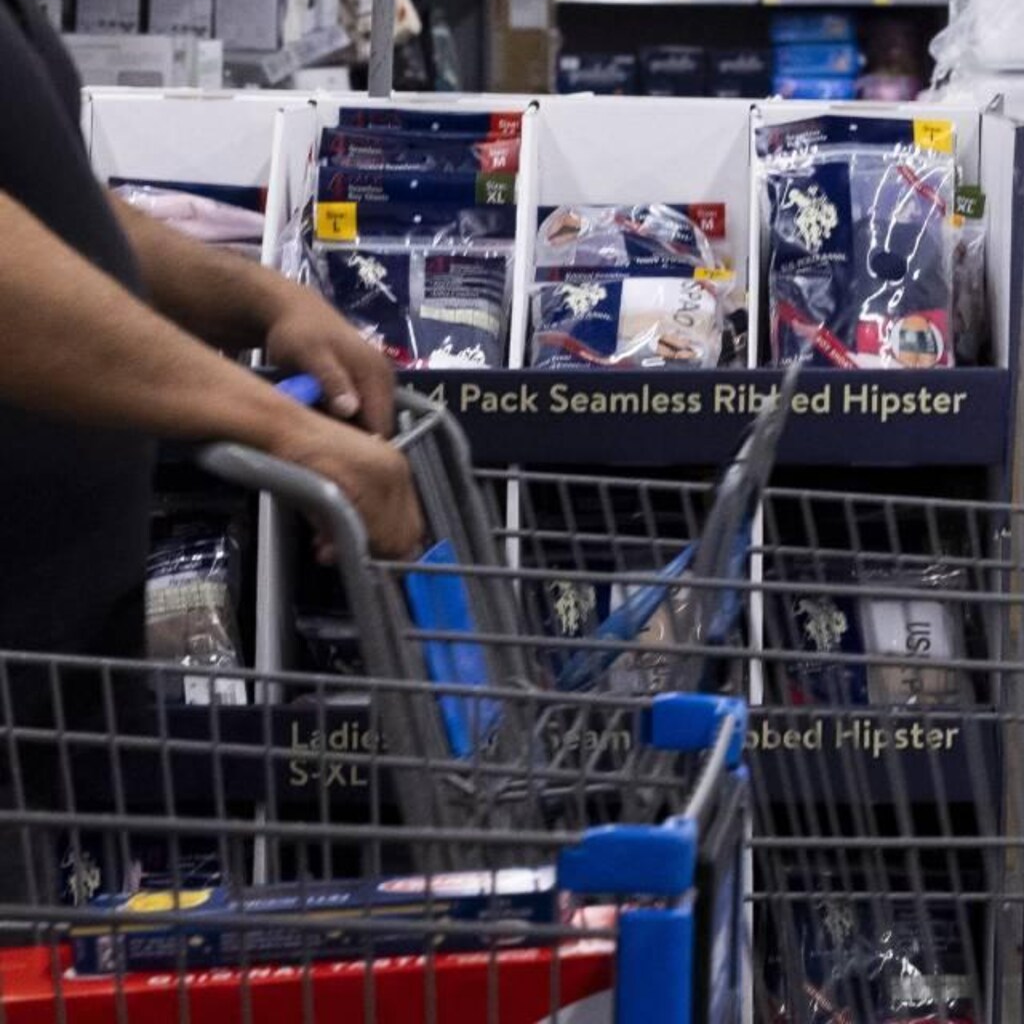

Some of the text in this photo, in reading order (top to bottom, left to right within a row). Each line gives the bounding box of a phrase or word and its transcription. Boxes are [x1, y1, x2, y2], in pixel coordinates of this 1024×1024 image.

[486, 191, 506, 205] XL
[459, 382, 539, 413] Pack
[549, 382, 702, 414] Seamless
[842, 385, 968, 423] Hipster
[836, 719, 960, 759] Hipster
[289, 759, 368, 787] S-XL
